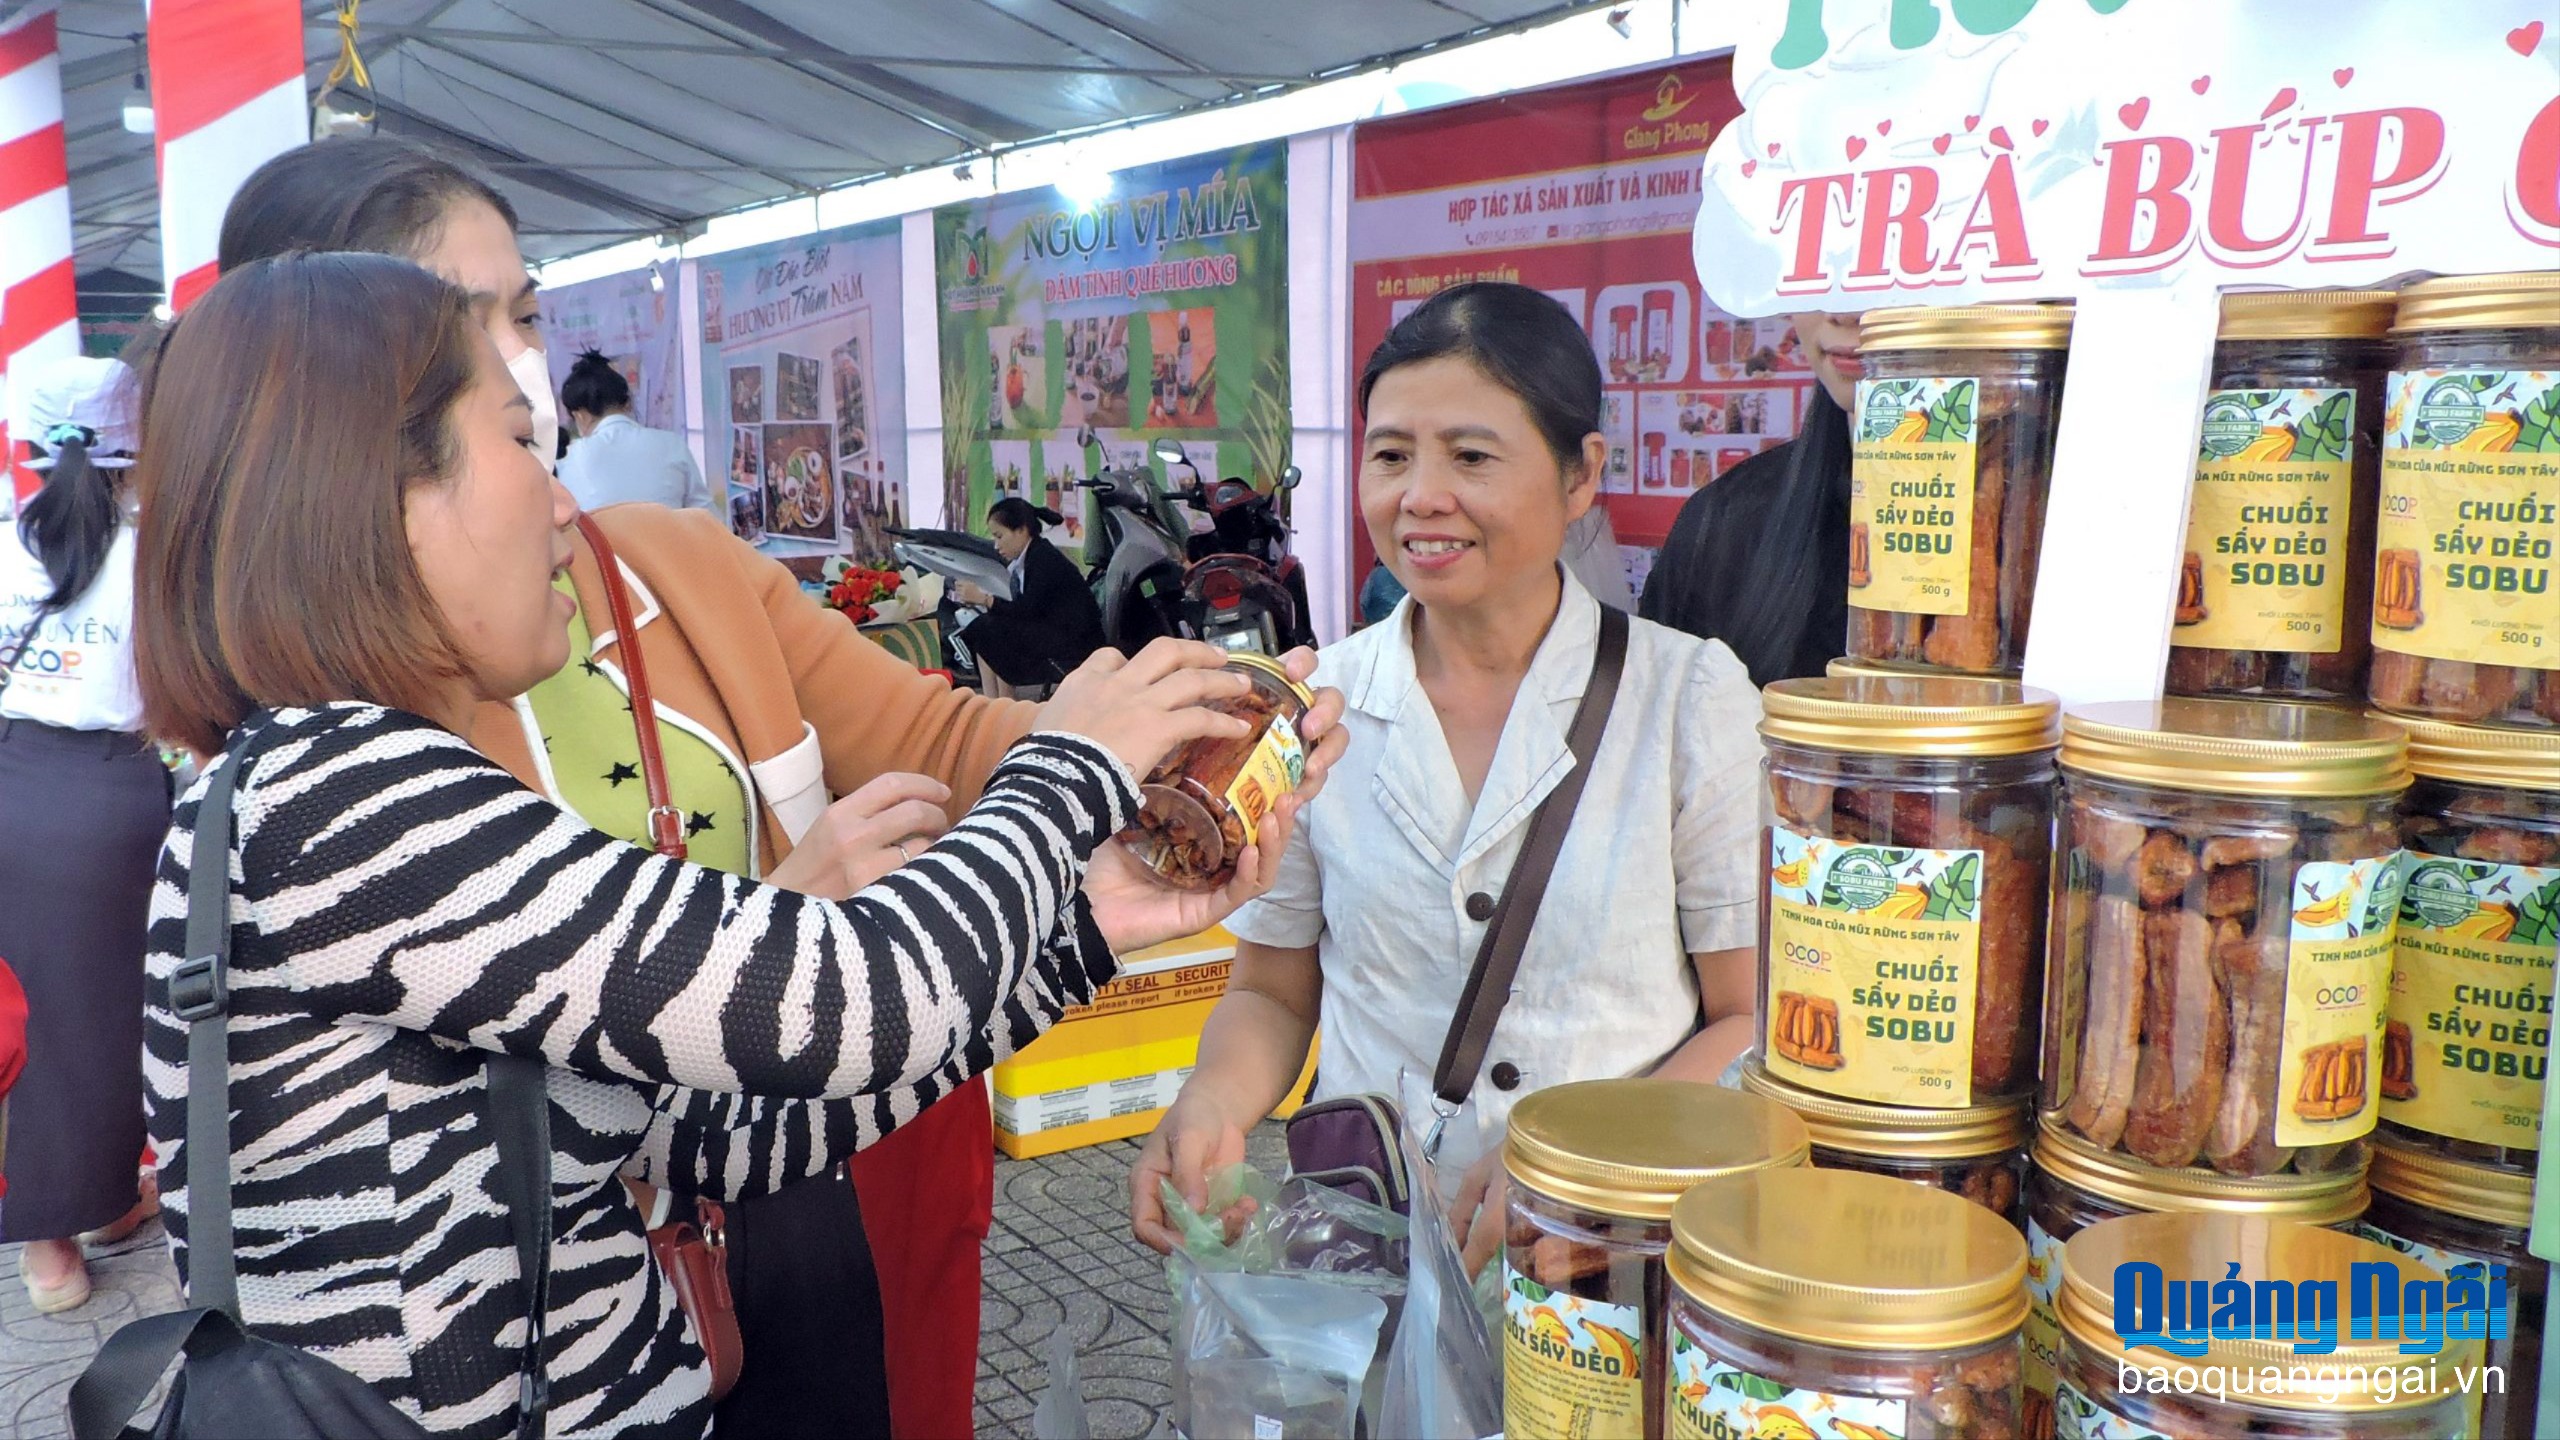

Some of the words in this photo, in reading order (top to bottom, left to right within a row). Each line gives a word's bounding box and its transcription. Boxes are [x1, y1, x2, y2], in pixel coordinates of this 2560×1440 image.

[1664, 120, 1709, 145] Phong
[1448, 198, 1477, 227] HỢP
[1481, 190, 1509, 218] TÁC
[1513, 186, 1533, 214] XÃ
[1538, 178, 1569, 212] SẢN
[1573, 171, 1615, 208] XUẤT
[1620, 171, 1641, 201] VÀ
[1646, 170, 1690, 198] KINH
[1770, 126, 2044, 294] TRÀ
[2079, 87, 2452, 276] BÚP
[1023, 203, 1123, 262] NGỌT
[1131, 191, 1169, 252] VỊ
[1174, 168, 1260, 239] MÍA
[831, 272, 864, 307] NĂM
[1123, 261, 1163, 299] QUÊ
[1377, 275, 1404, 297] CÁC
[2195, 469, 2210, 482] ỦA
[2277, 471, 2304, 482] SƠN
[2306, 470, 2330, 482] TÂY
[2498, 464, 2526, 476] SƠN
[2531, 464, 2559, 477] TÂY
[1890, 473, 1956, 498] CHUỐI
[1876, 500, 1908, 525] SẤY
[1912, 504, 1954, 527] DẺO
[2241, 496, 2329, 524] CHUỐI
[2459, 492, 2556, 524] CHUỐI
[1884, 531, 1953, 555] SOBU
[2216, 526, 2267, 554] SẤY
[2273, 531, 2327, 556] DẺO
[2433, 523, 2483, 554] SẤY
[2490, 530, 2552, 560] DẺO
[2231, 562, 2325, 587] SOBU
[2446, 563, 2549, 594] SOBU
[1921, 584, 1941, 595] 500
[1943, 587, 1951, 598] g
[2286, 620, 2310, 631] 500
[2313, 623, 2322, 634] g
[2501, 631, 2528, 644] 500
[2532, 635, 2542, 648] g
[1781, 908, 1801, 922] TINH
[1803, 913, 1823, 927] HOA
[1825, 916, 1846, 931] CỦA
[1873, 926, 1907, 939] RỪNG
[1910, 929, 1935, 941] SƠN
[1937, 930, 1960, 942] TÂY
[1784, 941, 1832, 966] OCOP
[2495, 954, 2524, 967] SƠN
[1174, 963, 1232, 984] SECURIT
[1876, 955, 1958, 982] CHUỐI
[1124, 976, 1160, 995] SEAL
[1174, 989, 1182, 998] if
[1183, 985, 1215, 997] broken
[1852, 980, 1900, 1009] SẤY
[1907, 990, 1957, 1013] DẺO
[2316, 984, 2368, 1005] OCOP
[2454, 982, 2553, 1014] CHUỐI
[1065, 1004, 1093, 1015] roken
[1096, 999, 1129, 1012] please
[1131, 993, 1160, 1006] report
[1866, 1015, 1955, 1044] SOBU
[2427, 1006, 2482, 1038] SẤY
[2490, 1017, 2550, 1048] DẺO
[2442, 1043, 2548, 1080] SOBU
[1919, 1075, 1942, 1087] 500
[1944, 1078, 1952, 1090] g
[2503, 1114, 2530, 1128] 500
[1504, 1311, 1527, 1347] UỐI
[1529, 1328, 1565, 1363] SẤY
[1572, 1346, 1620, 1376] DẺO
[2029, 1337, 2056, 1367] OCO
